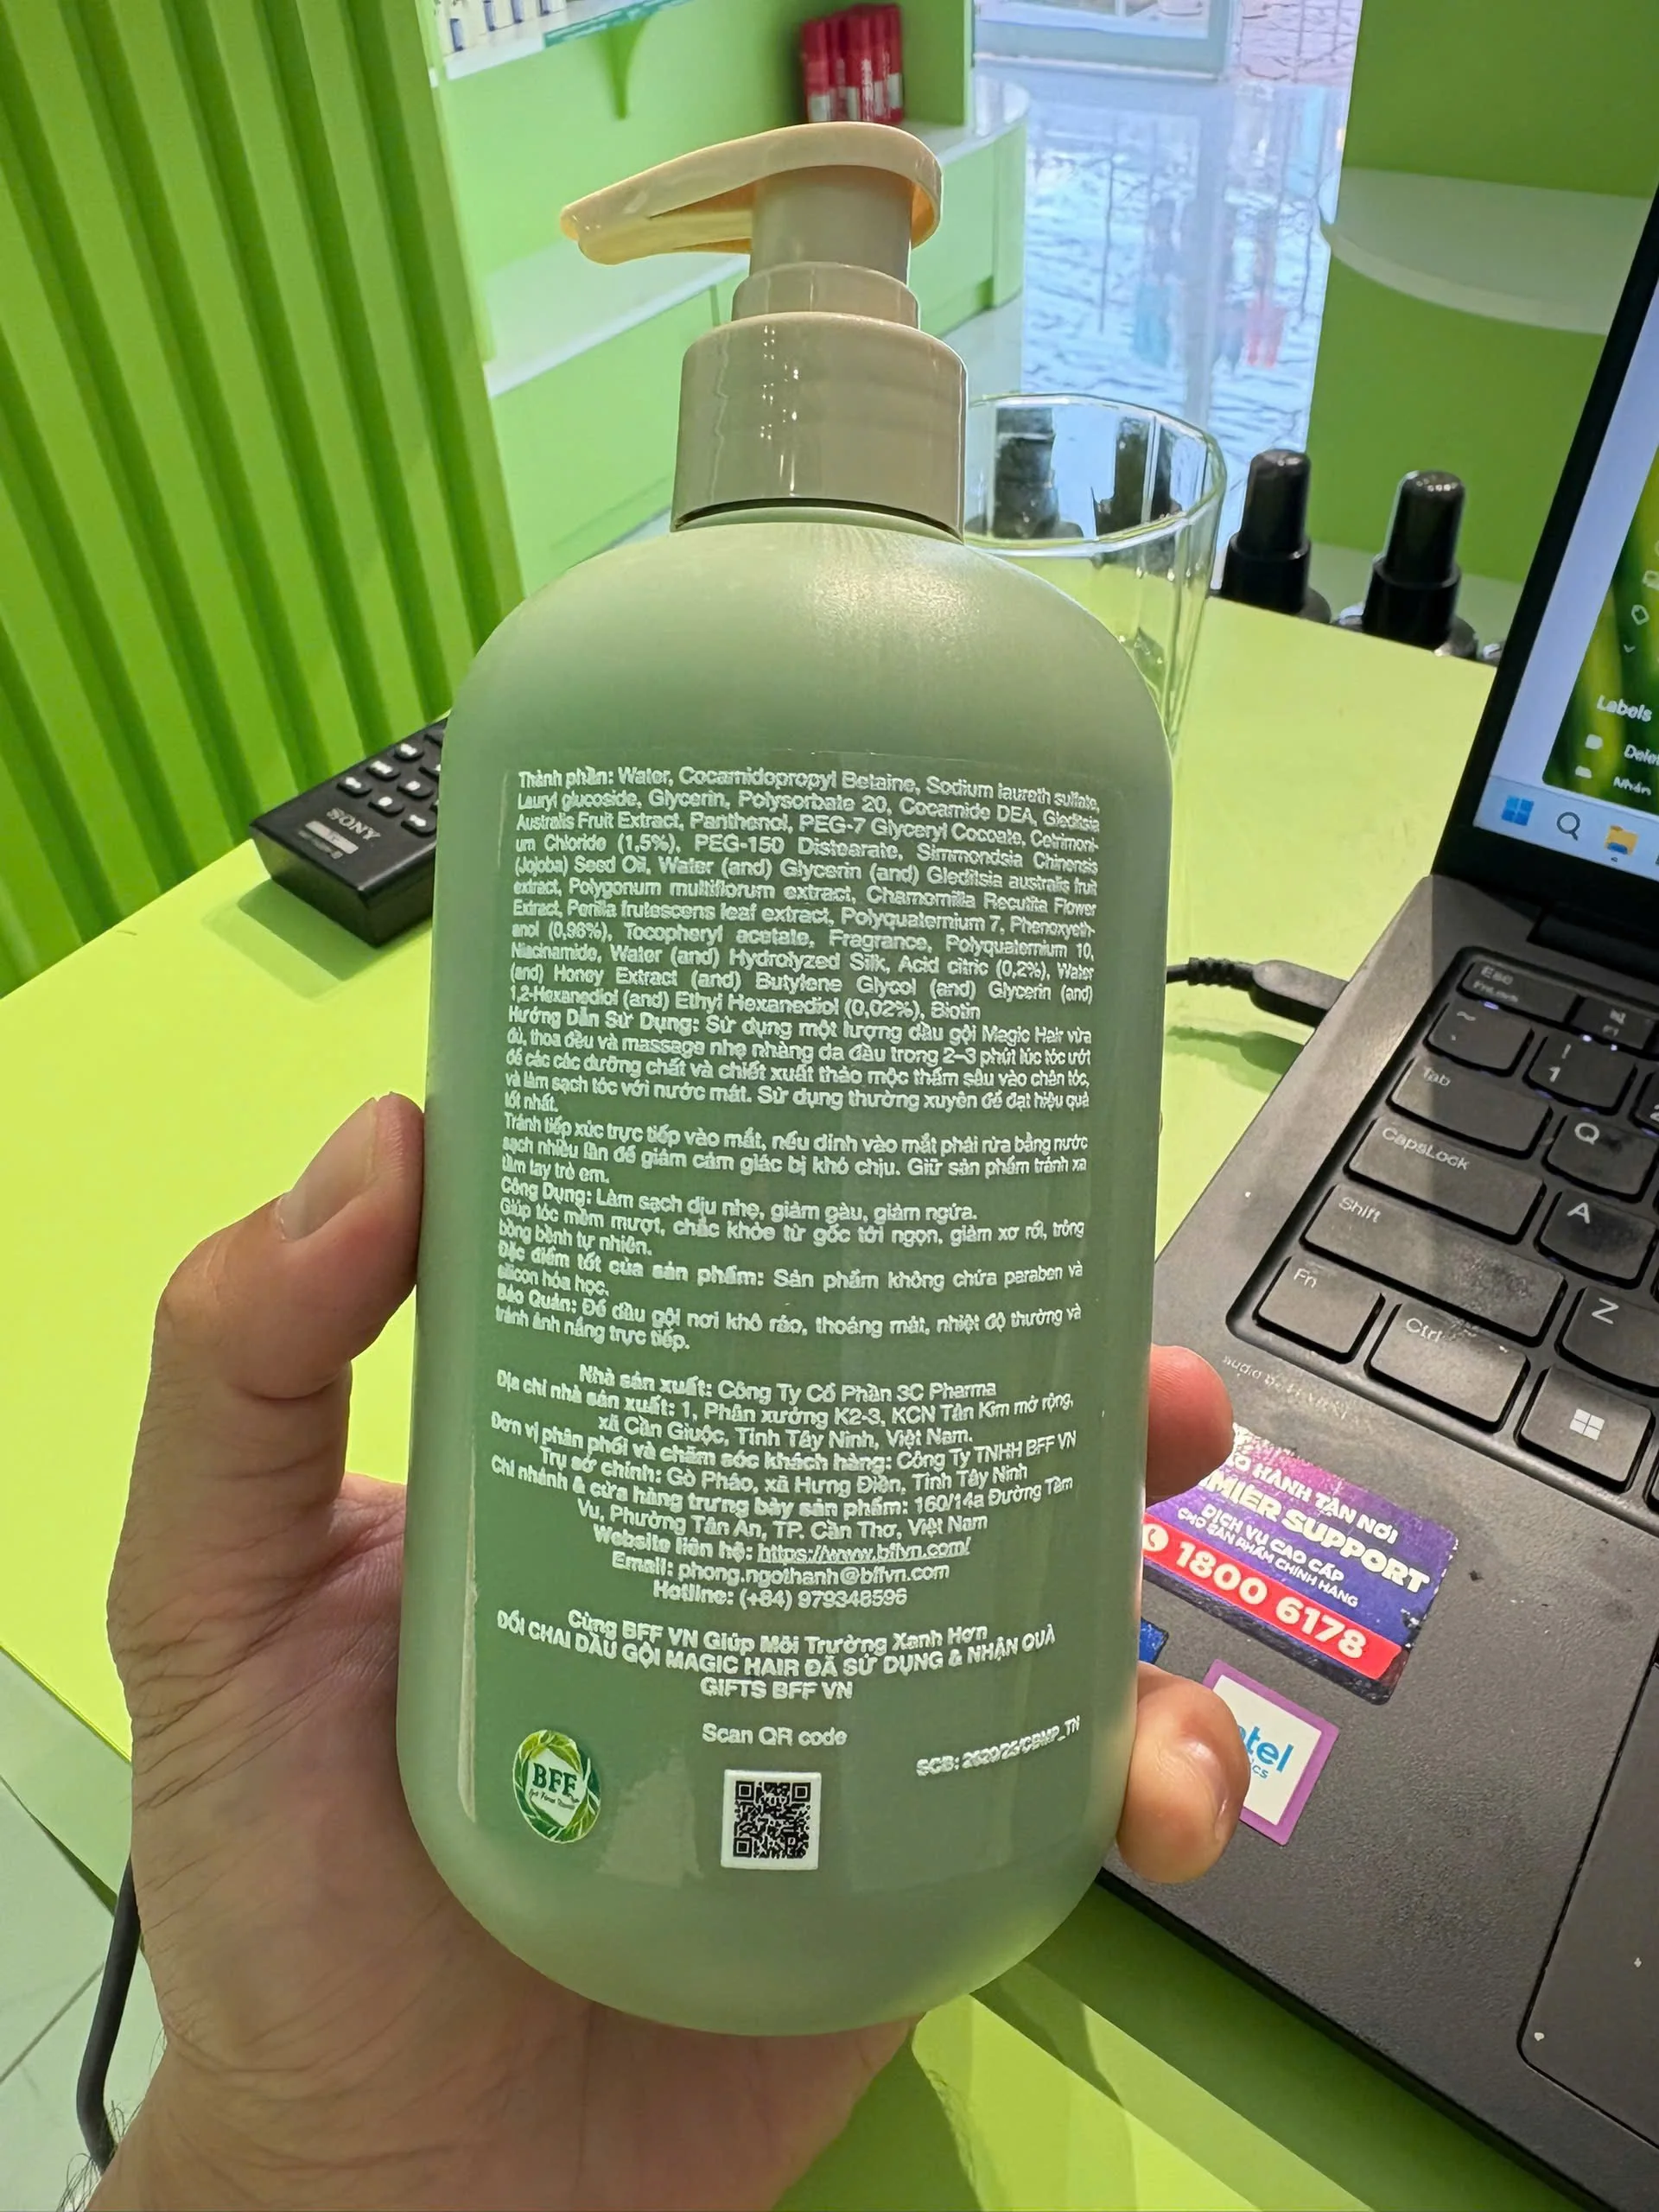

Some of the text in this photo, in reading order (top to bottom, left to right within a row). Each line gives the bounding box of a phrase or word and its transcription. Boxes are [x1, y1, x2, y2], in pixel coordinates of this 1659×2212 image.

[678, 766, 836, 791] Cocamidopropyl
[926, 776, 994, 799] Sodium
[899, 797, 991, 821] Cocamide
[327, 807, 381, 840] SONY
[799, 814, 865, 835] PEG-7
[871, 817, 947, 843] Glyceryl
[694, 834, 785, 855] PEG-150
[1574, 1122, 1600, 1145] Q
[1382, 1127, 1470, 1171] CapsLock
[1338, 1196, 1382, 1224] Shift
[1567, 1202, 1591, 1224] A
[1294, 1268, 1318, 1289] Fn
[1591, 1298, 1619, 1325] Z
[1405, 1317, 1444, 1344] Ctrl
[718, 1381, 771, 1406] Công
[778, 1383, 802, 1407] Ty
[930, 1382, 996, 1401] Pharma
[892, 1406, 935, 1425] KCN
[950, 1448, 970, 1469] Ty
[975, 1441, 1022, 1464] TNHH
[1027, 1435, 1054, 1457] BFF
[1058, 1430, 1077, 1450] VN
[772, 1521, 804, 1541] TP.
[948, 1515, 988, 1534] Nam
[1198, 1469, 1431, 1594] MIER SUPPORT
[1175, 1541, 1368, 1660] 1800 6178
[622, 1620, 663, 1643] BFF
[668, 1628, 698, 1649] VN
[665, 1649, 738, 1675] MAGIC
[744, 1657, 799, 1677] HAIR
[701, 1676, 853, 1700] GIFTS BFF VN
[702, 1723, 848, 1747] Scan QR code
[532, 1763, 577, 1796] BFF
